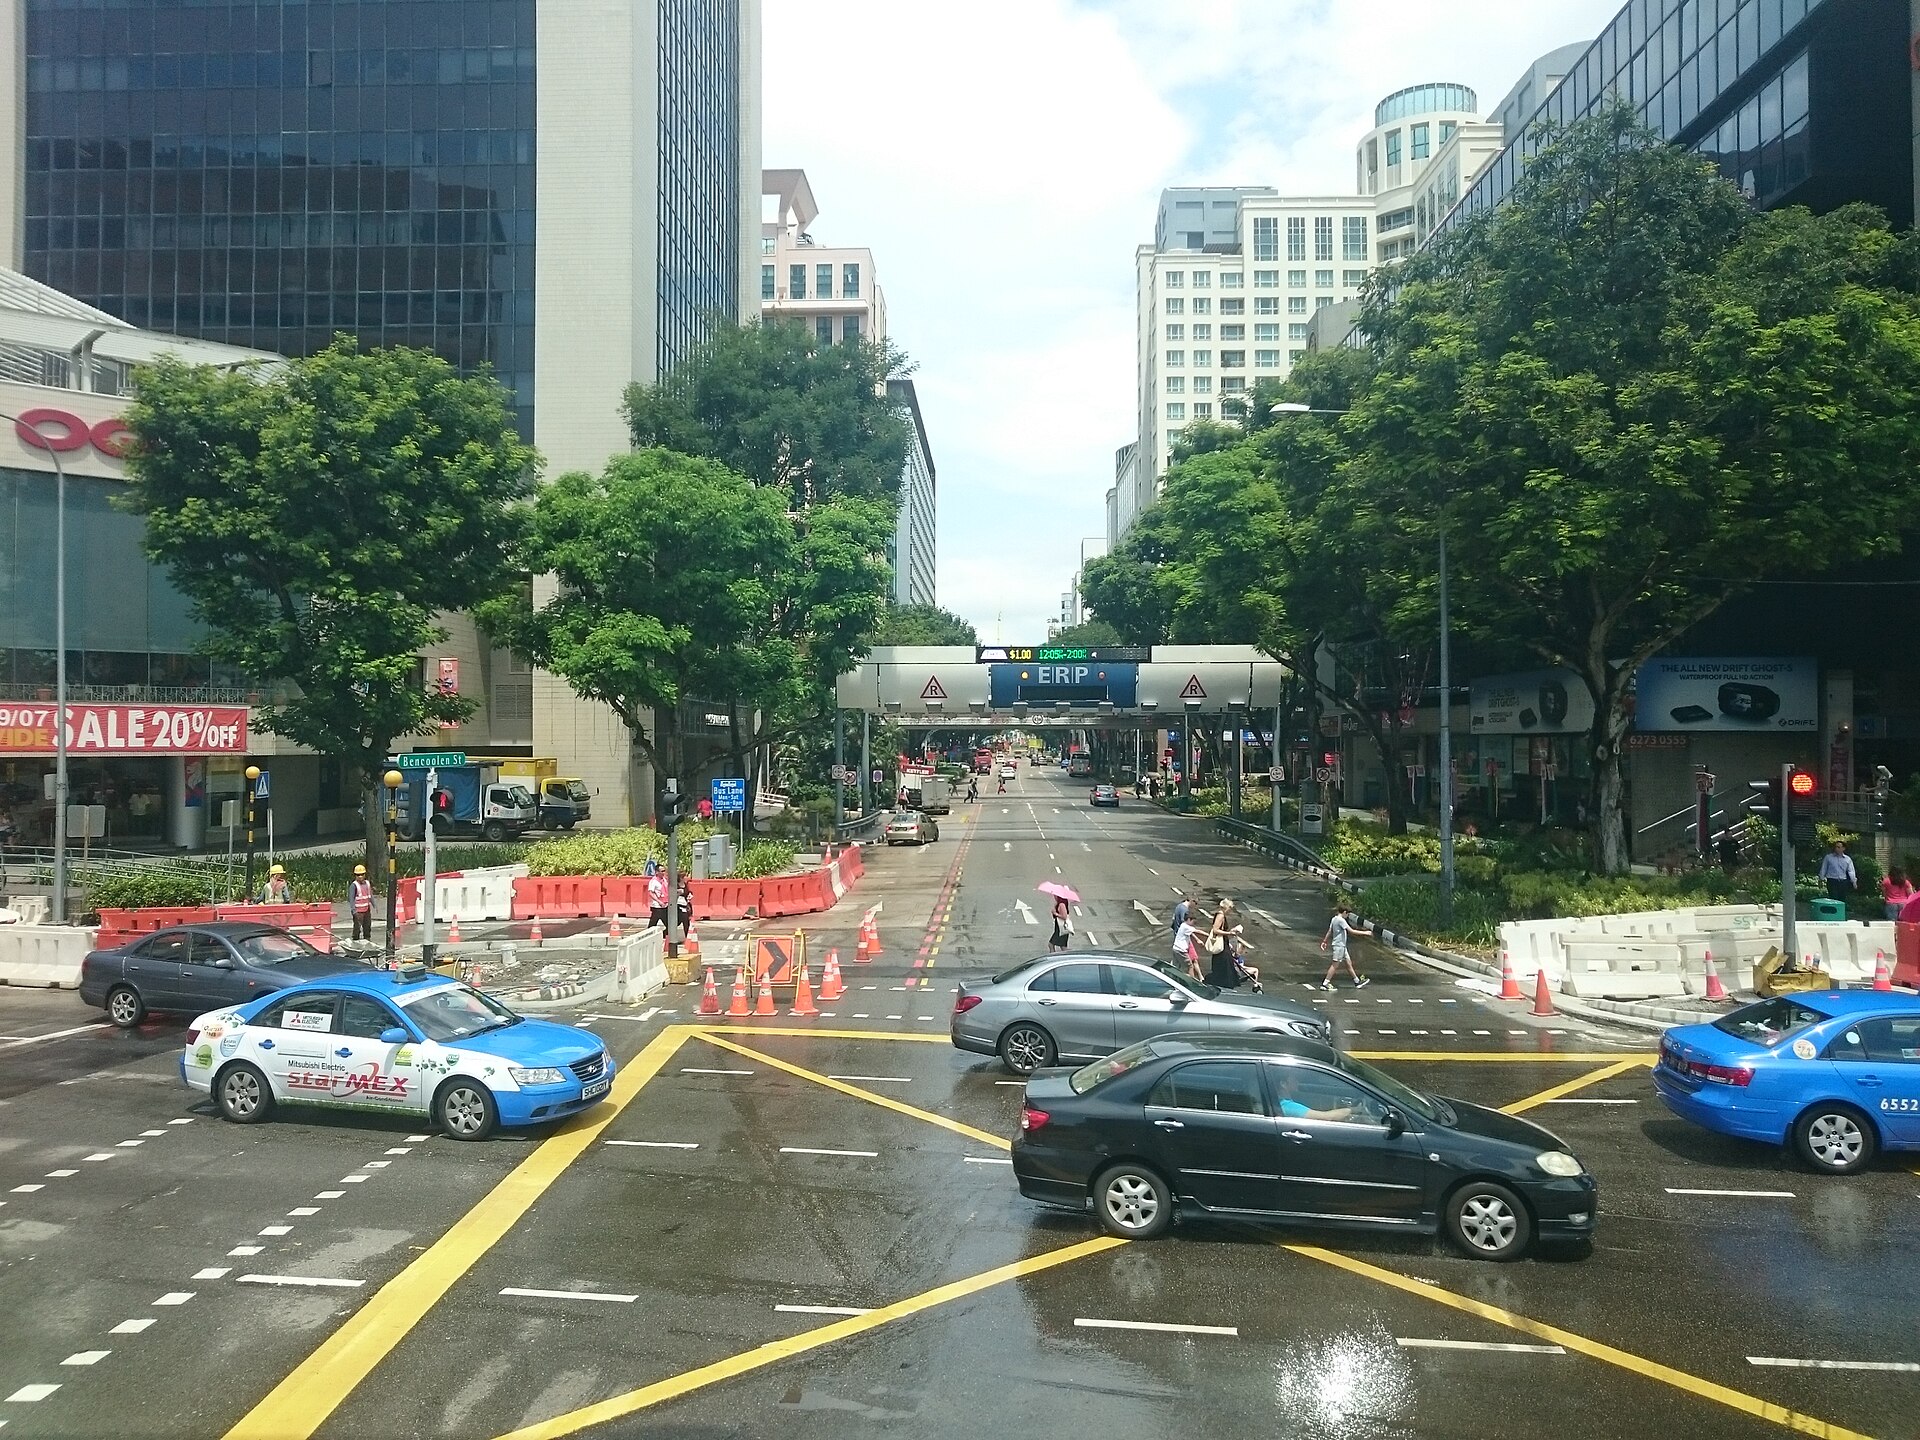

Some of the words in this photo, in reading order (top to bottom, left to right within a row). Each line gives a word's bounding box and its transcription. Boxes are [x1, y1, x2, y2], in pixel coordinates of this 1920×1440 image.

[1009, 649, 1032, 660] $1.00
[1661, 664, 1679, 673] THE
[1681, 664, 1697, 673] ALL
[1699, 664, 1720, 673] NEW
[1722, 664, 1748, 673] DRIFT
[1751, 664, 1793, 673] GHOST-S
[1038, 666, 1089, 684] ERP
[930, 685, 938, 696] R
[1189, 684, 1198, 695] R
[52, 709, 145, 748] SALE
[152, 711, 212, 748] 20%
[207, 725, 238, 748] OFF
[1630, 735, 1657, 745] 6273
[1659, 735, 1686, 745] 0555
[403, 755, 450, 767] Bencoolen
[453, 754, 462, 765] St
[713, 786, 726, 795] Bus
[727, 786, 743, 795] Lane
[288, 1059, 321, 1070] Mitsubishi
[321, 1062, 346, 1072] Electric
[1880, 1098, 1919, 1111] 6552
